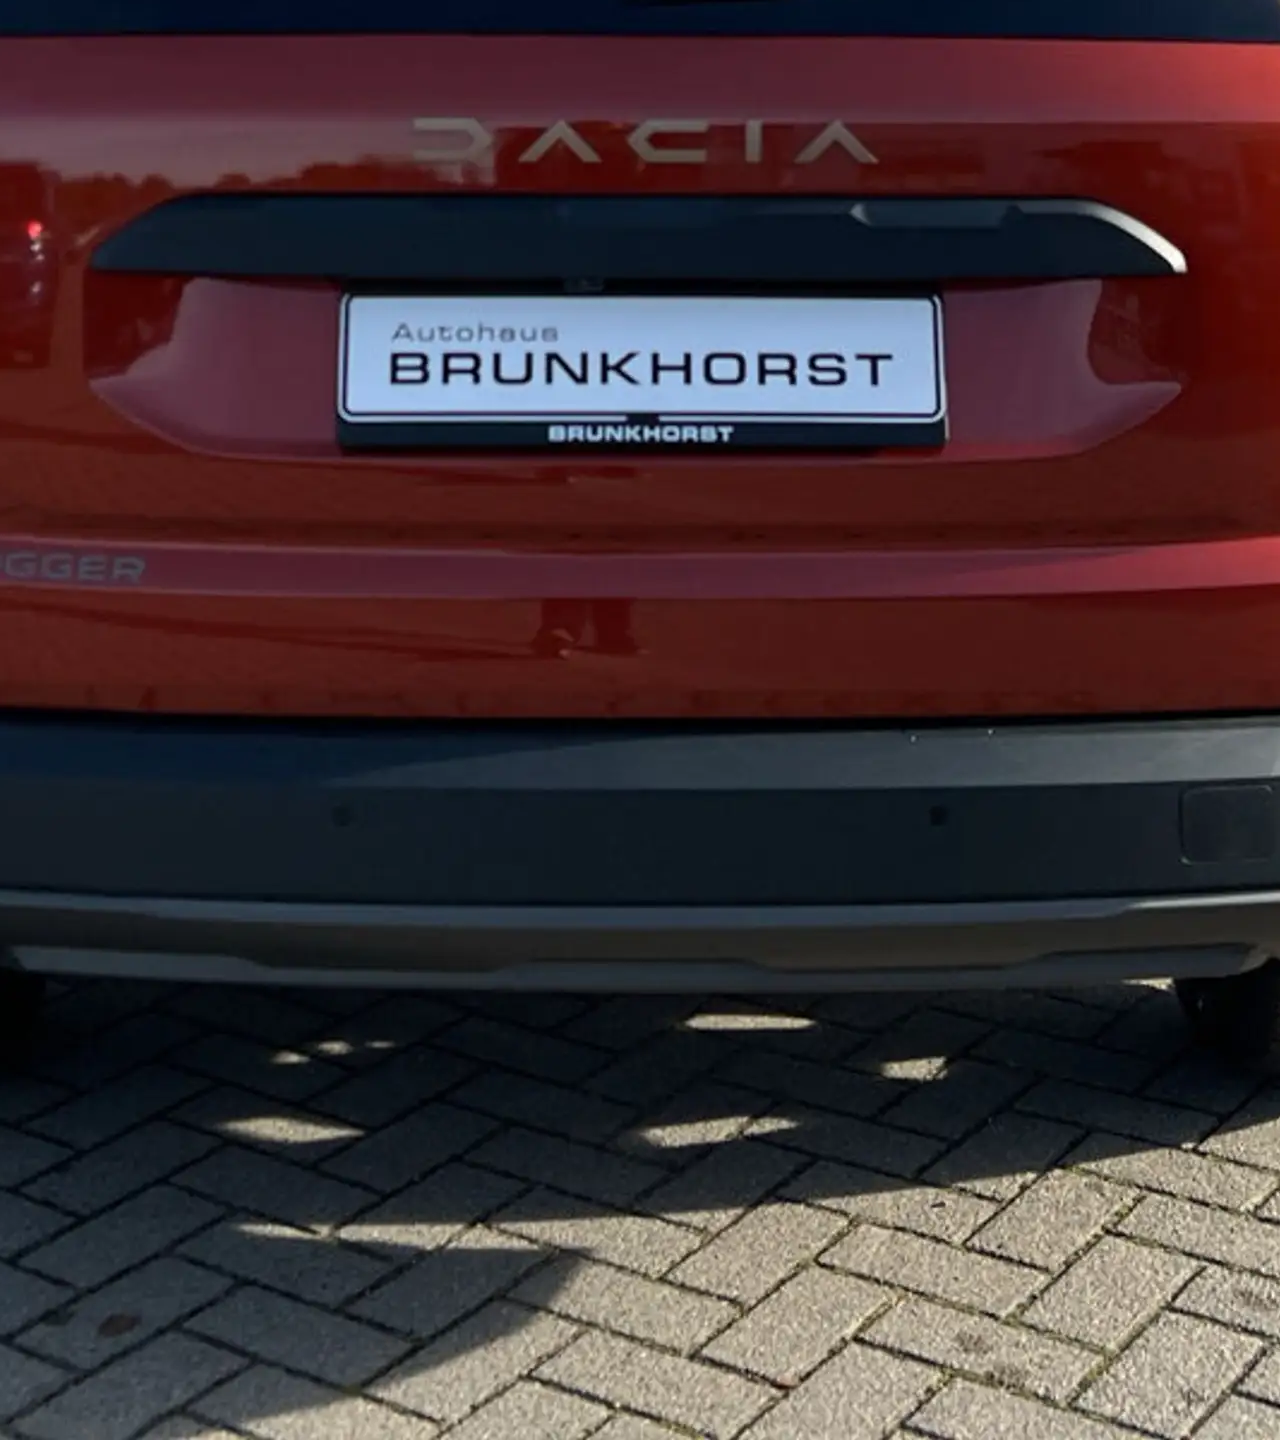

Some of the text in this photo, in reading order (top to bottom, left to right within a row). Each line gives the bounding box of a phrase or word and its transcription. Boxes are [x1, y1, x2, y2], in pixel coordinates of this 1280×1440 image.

[412, 116, 881, 164] DACIA
[391, 321, 559, 343] Autohaus
[390, 351, 894, 387] BRUNKHORST
[548, 424, 734, 442] BRUNKHORST
